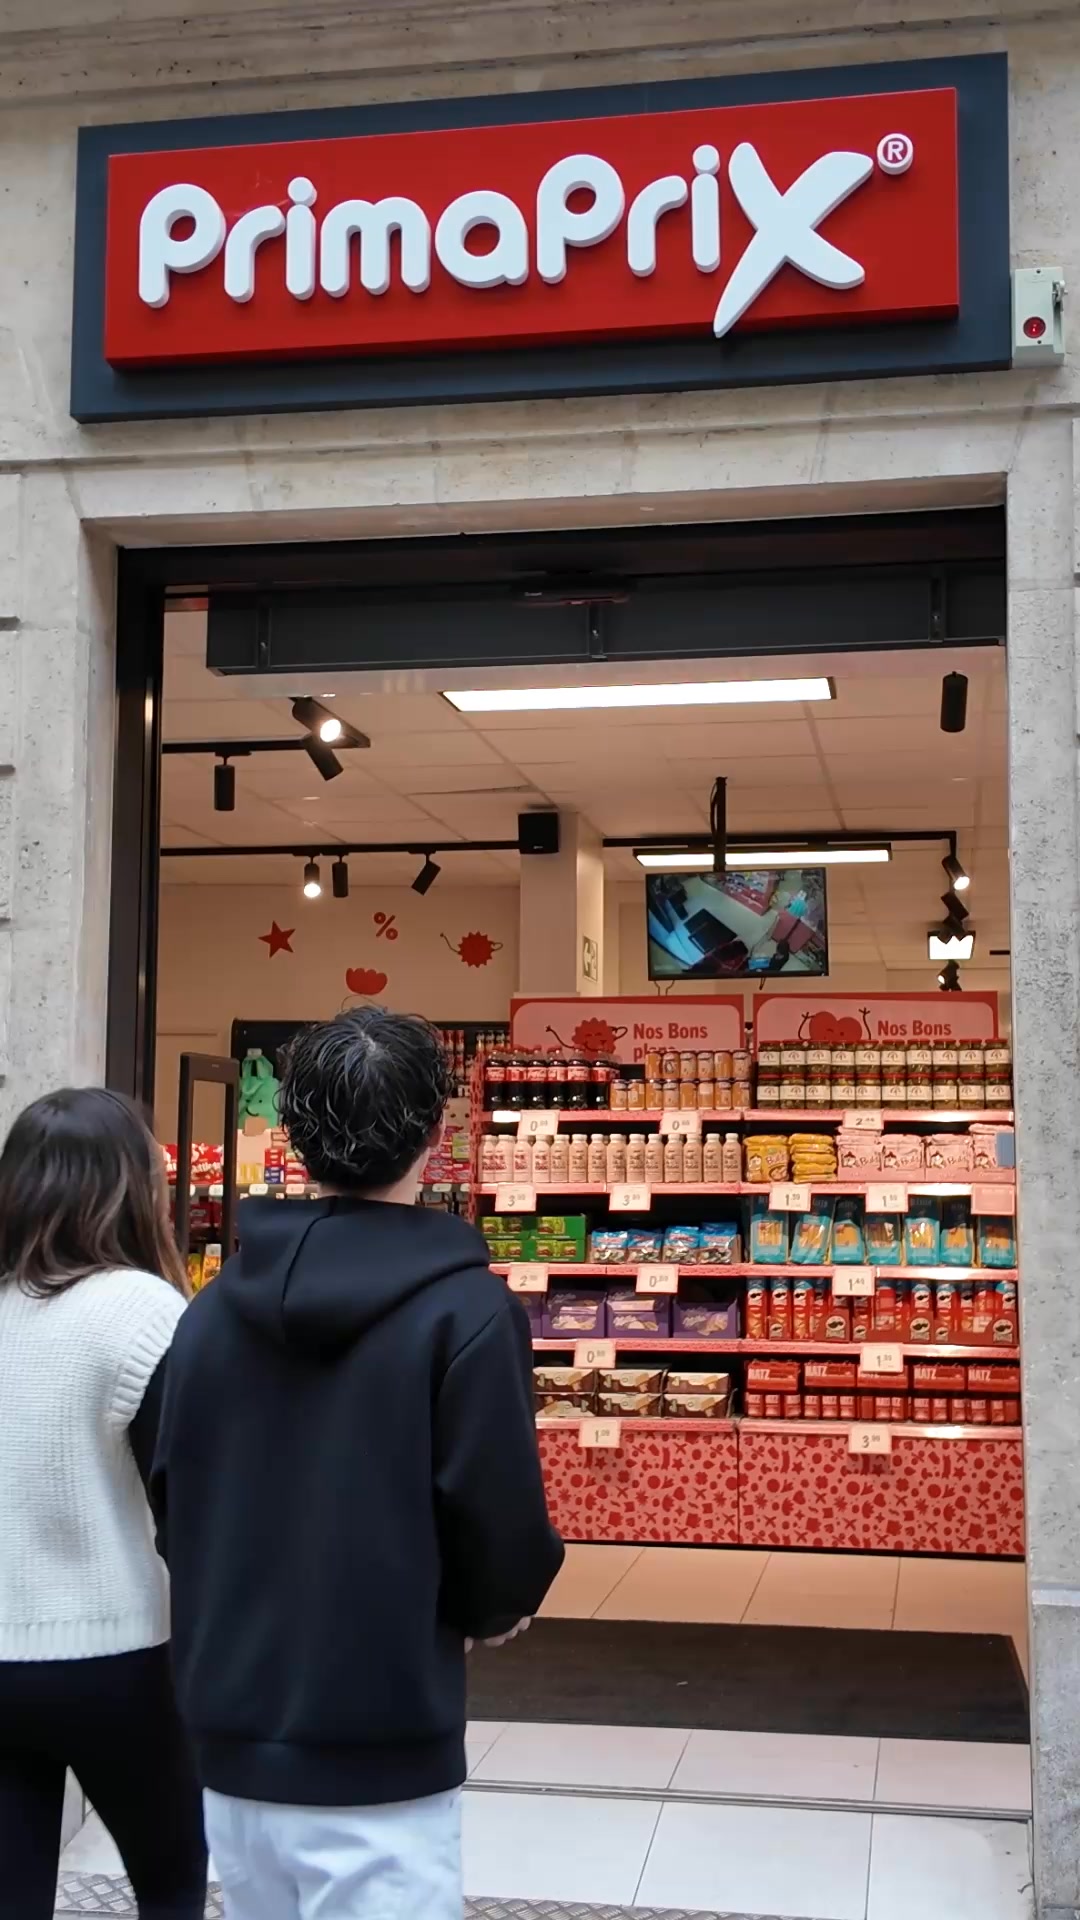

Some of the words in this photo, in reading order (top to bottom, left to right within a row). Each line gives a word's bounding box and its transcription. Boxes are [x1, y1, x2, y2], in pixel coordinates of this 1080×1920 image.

[633, 1023, 663, 1040] Nos
[668, 1022, 708, 1039] Bons
[877, 1019, 908, 1036] Nos
[912, 1019, 952, 1037] Bons
